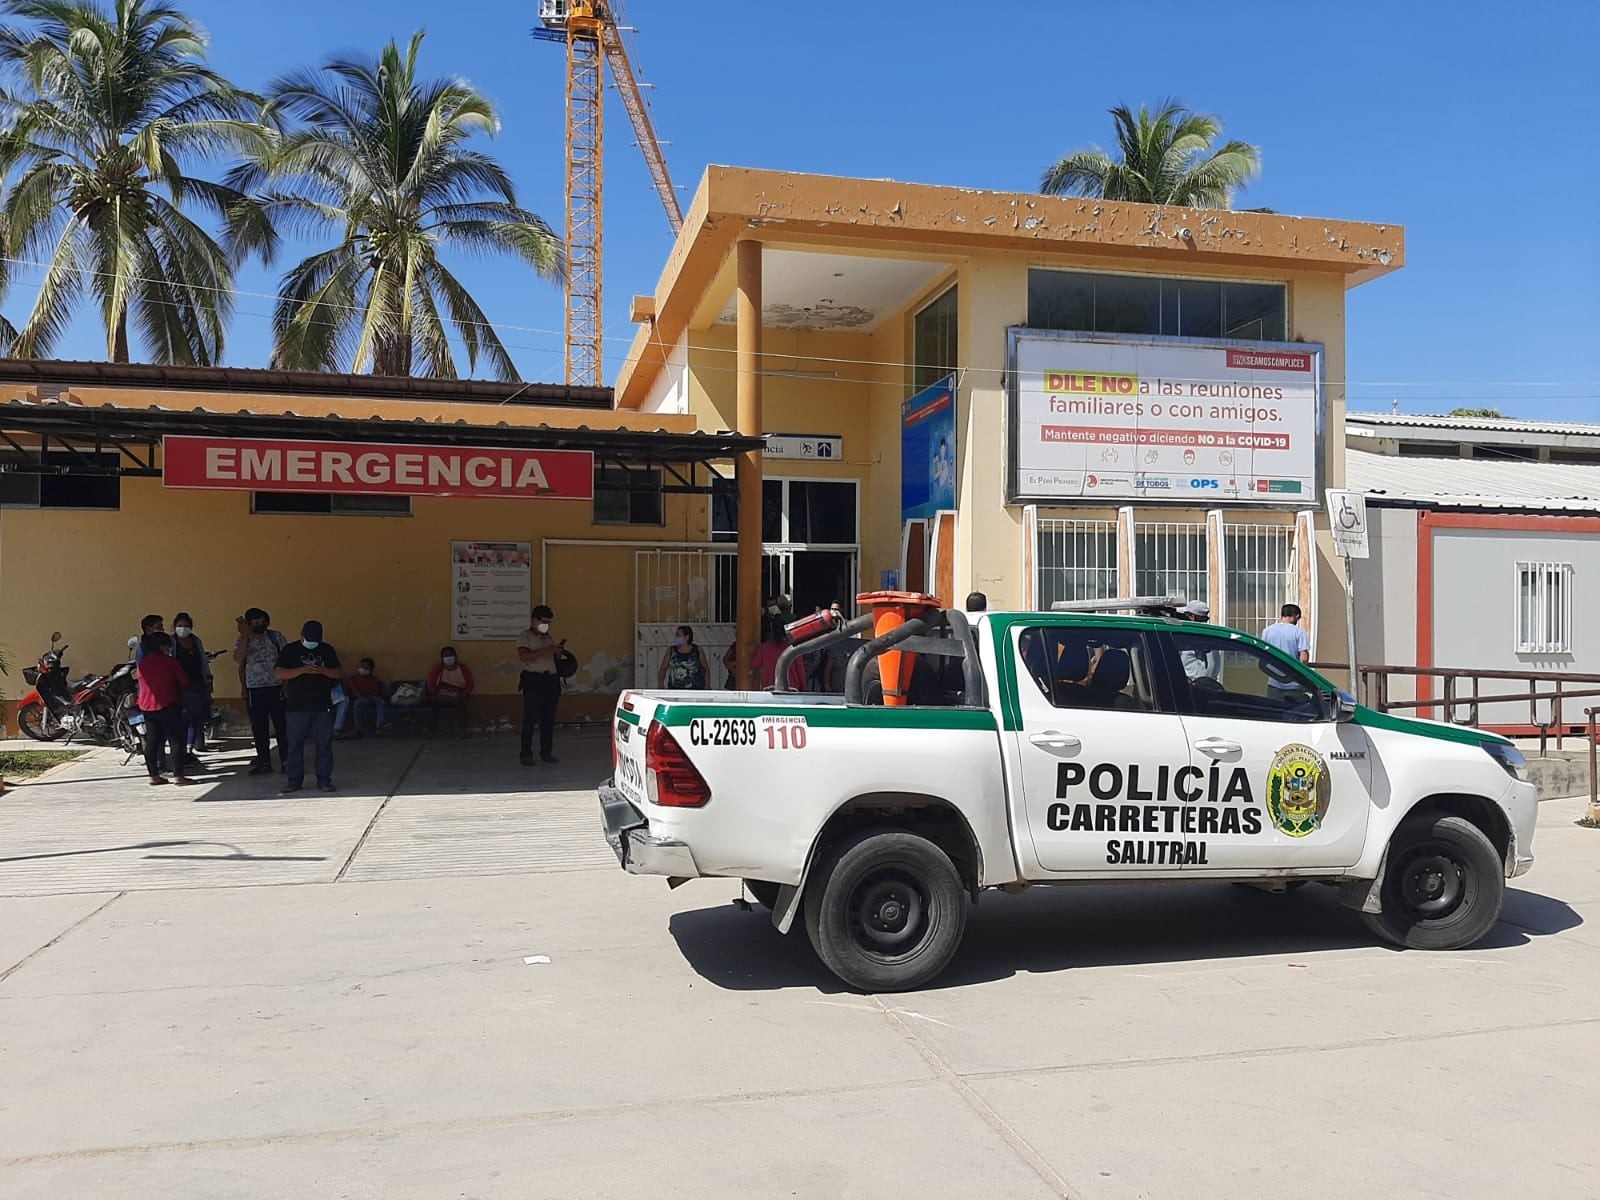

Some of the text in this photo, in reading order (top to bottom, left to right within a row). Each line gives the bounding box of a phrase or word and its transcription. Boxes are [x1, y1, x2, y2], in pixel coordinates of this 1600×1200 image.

[1048, 374, 1283, 400] DILE NO a las reuniones
[1049, 396, 1283, 423] familiares o con amigos.
[1044, 429, 1287, 448] Mantente negativo diciendo NO a la COVID-19
[206, 448, 549, 489] EMERGENCIA
[1190, 479, 1219, 489] OPS
[690, 719, 757, 746] CL-22639
[763, 725, 807, 750] 110
[1055, 759, 1255, 803] POLICÍA
[1046, 803, 1262, 835] CARRETERAS
[1106, 840, 1209, 865] SALITRAL
